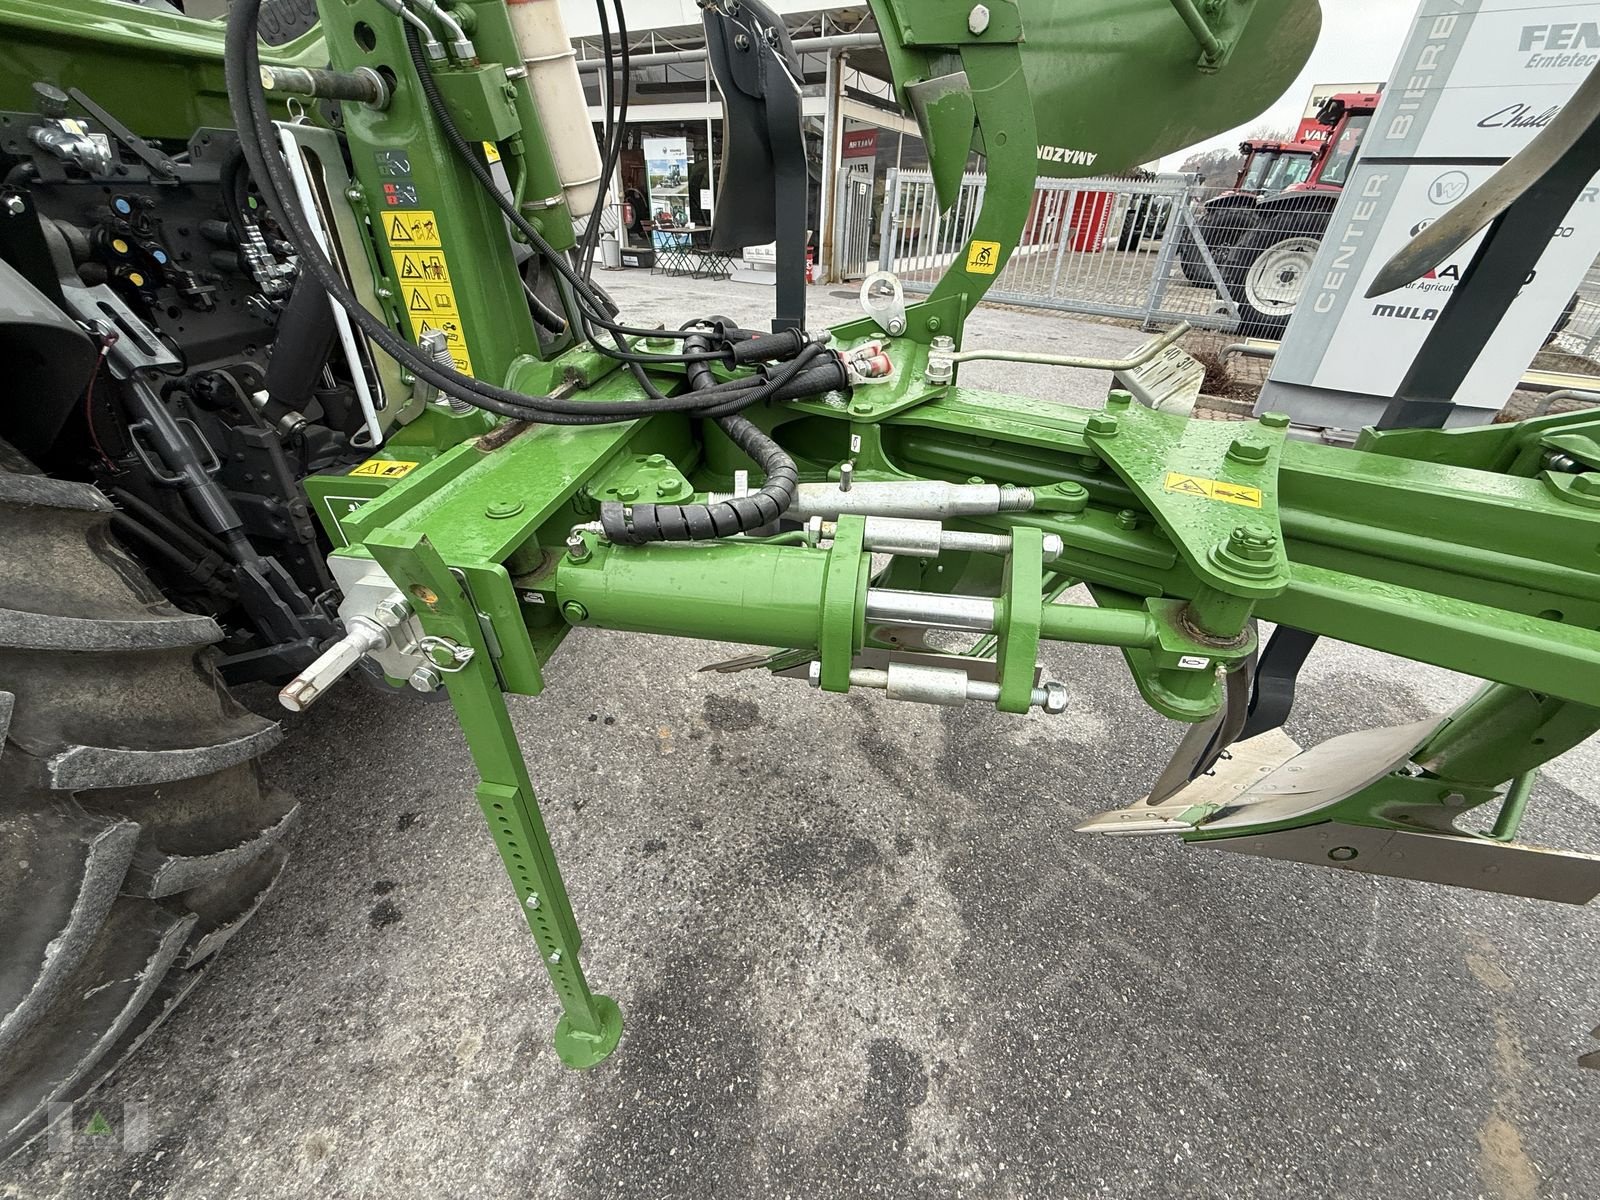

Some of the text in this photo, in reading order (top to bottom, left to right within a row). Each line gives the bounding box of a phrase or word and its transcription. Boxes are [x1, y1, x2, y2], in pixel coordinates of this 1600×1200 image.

[1386, 0, 1465, 139] BIERB
[1313, 174, 1389, 313] CENTER
[1163, 347, 1196, 372] 40 30
